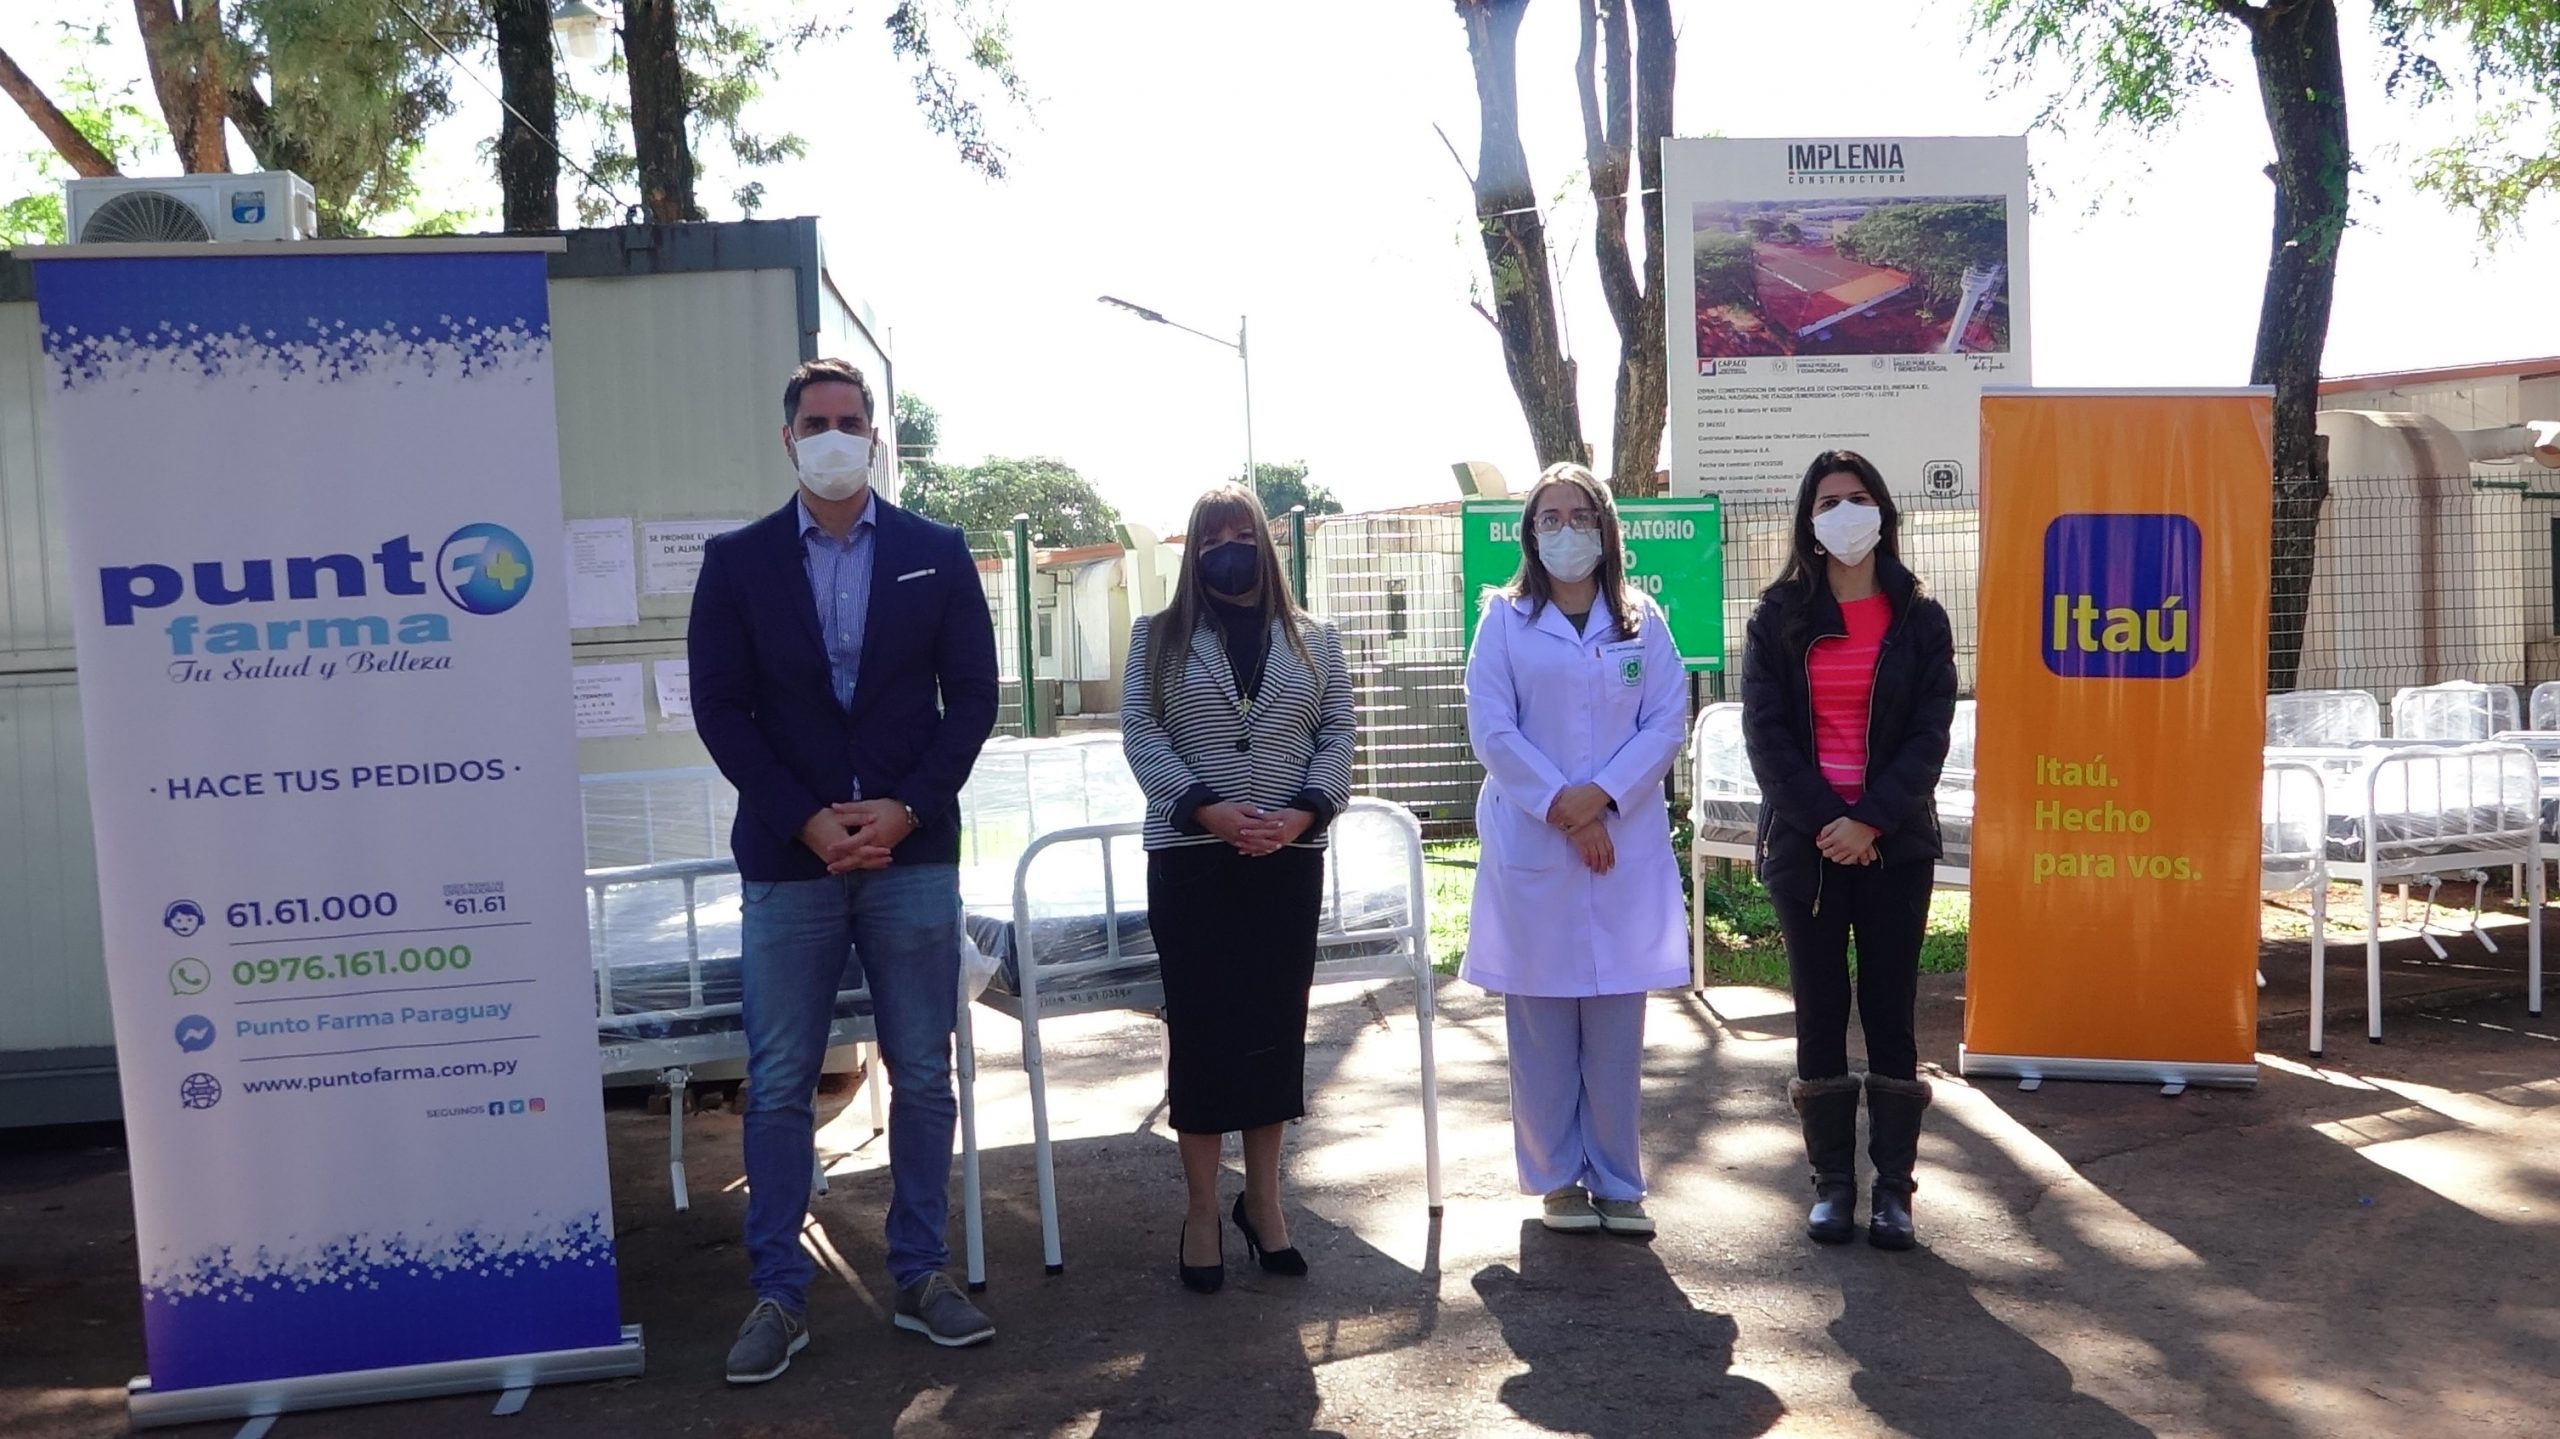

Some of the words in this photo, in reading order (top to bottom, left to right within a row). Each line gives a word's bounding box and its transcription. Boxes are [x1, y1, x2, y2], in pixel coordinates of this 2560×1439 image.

[1788, 143, 1904, 170] IMPLENIA
[1788, 175, 1905, 184] CONSTRUCTORA
[1619, 519, 1695, 540] RATORIO
[663, 545, 675, 554] DE
[165, 612, 452, 656] farma
[2052, 594, 2188, 653] Itaú
[167, 659, 214, 684] Tu
[223, 654, 314, 682] Salud
[319, 661, 338, 682] y
[346, 649, 454, 675] Belleza
[167, 773, 265, 800] HACE
[274, 768, 340, 793] TUS
[352, 758, 506, 788] PEDIDOS
[2035, 754, 2119, 788] Itaú.
[2034, 799, 2151, 833] Hecho
[2032, 851, 2116, 885] para
[2127, 853, 2203, 881] vos.
[226, 891, 399, 929] 61.61.000
[232, 944, 473, 986] 0976.161.000
[235, 1016, 311, 1038] Punto
[316, 1011, 395, 1032] Farma
[400, 1002, 513, 1025] Paraguay
[243, 1058, 519, 1094] www.puntofarma.com.py
